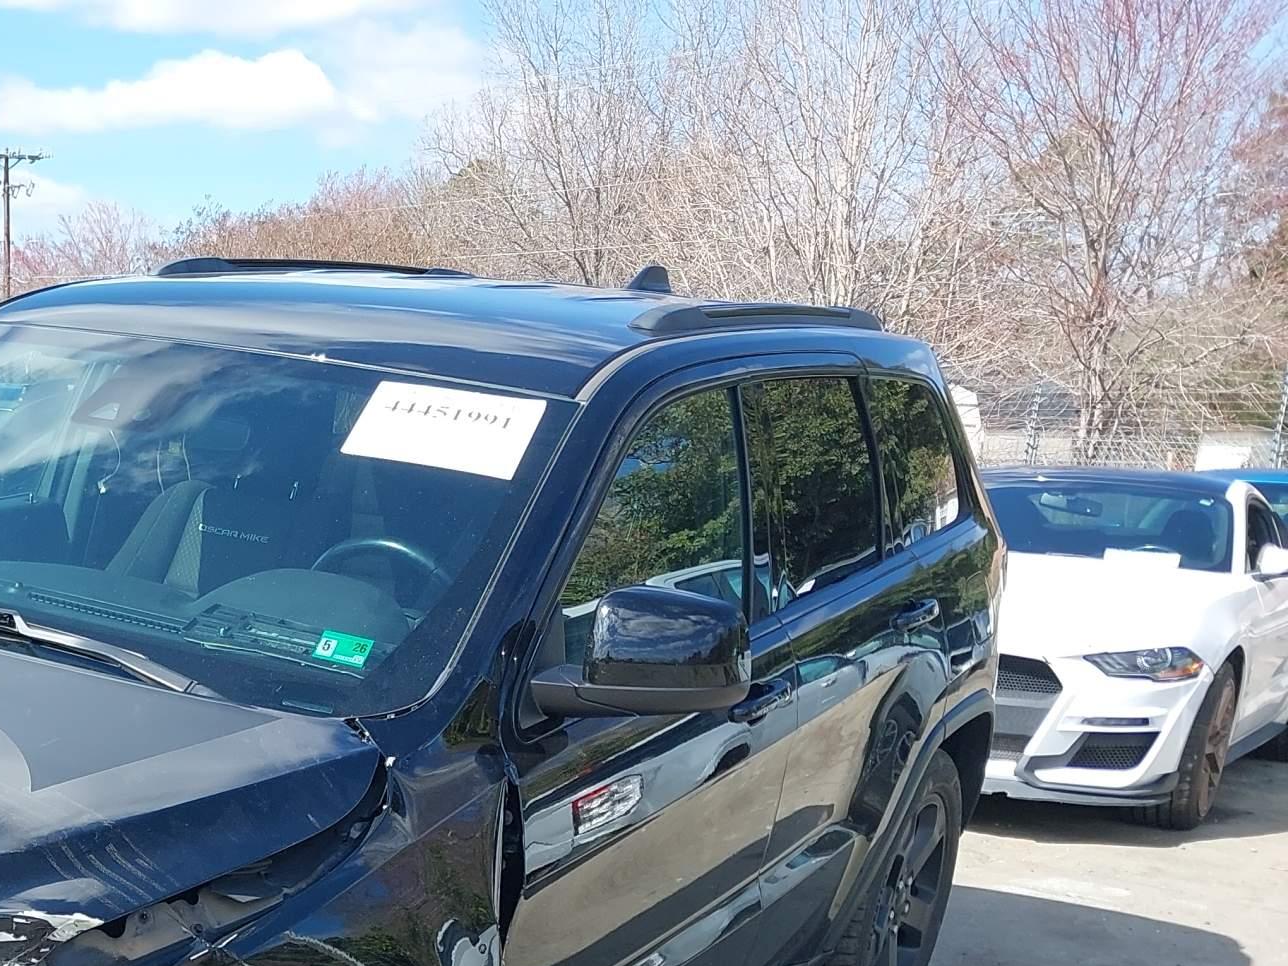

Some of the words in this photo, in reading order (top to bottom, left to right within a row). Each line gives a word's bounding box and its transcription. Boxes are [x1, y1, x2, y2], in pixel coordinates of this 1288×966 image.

[198, 523, 239, 538] OSCAR
[240, 531, 271, 544] MIKE
[321, 639, 332, 652] 5
[352, 642, 369, 654] 26
